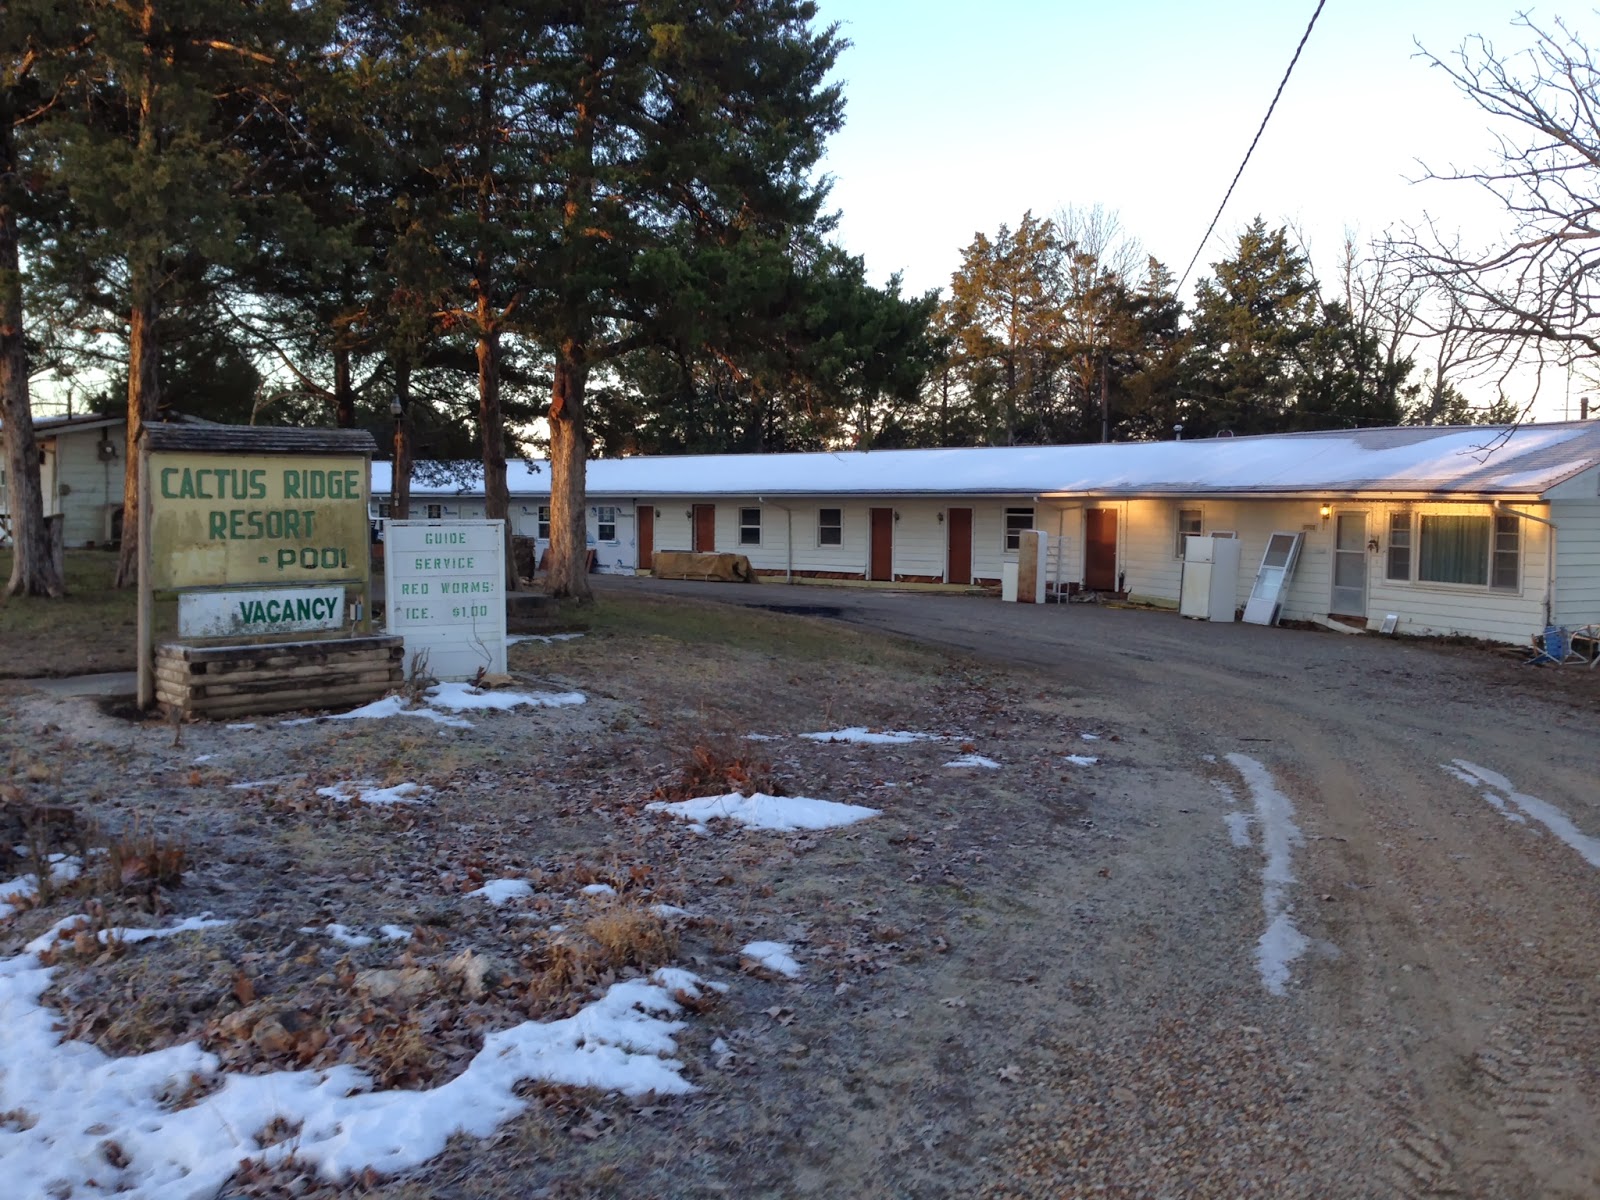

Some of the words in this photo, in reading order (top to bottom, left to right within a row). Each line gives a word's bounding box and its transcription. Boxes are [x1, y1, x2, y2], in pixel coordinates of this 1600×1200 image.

[161, 467, 266, 499] CACTUS
[283, 470, 360, 499] RIDGE
[209, 509, 315, 540] RESORT
[425, 533, 466, 544] GUIDE
[415, 557, 474, 570] SERVICE
[402, 583, 429, 595] RED
[441, 581, 494, 594] WORMS:
[239, 597, 338, 624] VACANCY
[452, 605, 487, 618] $1.00
